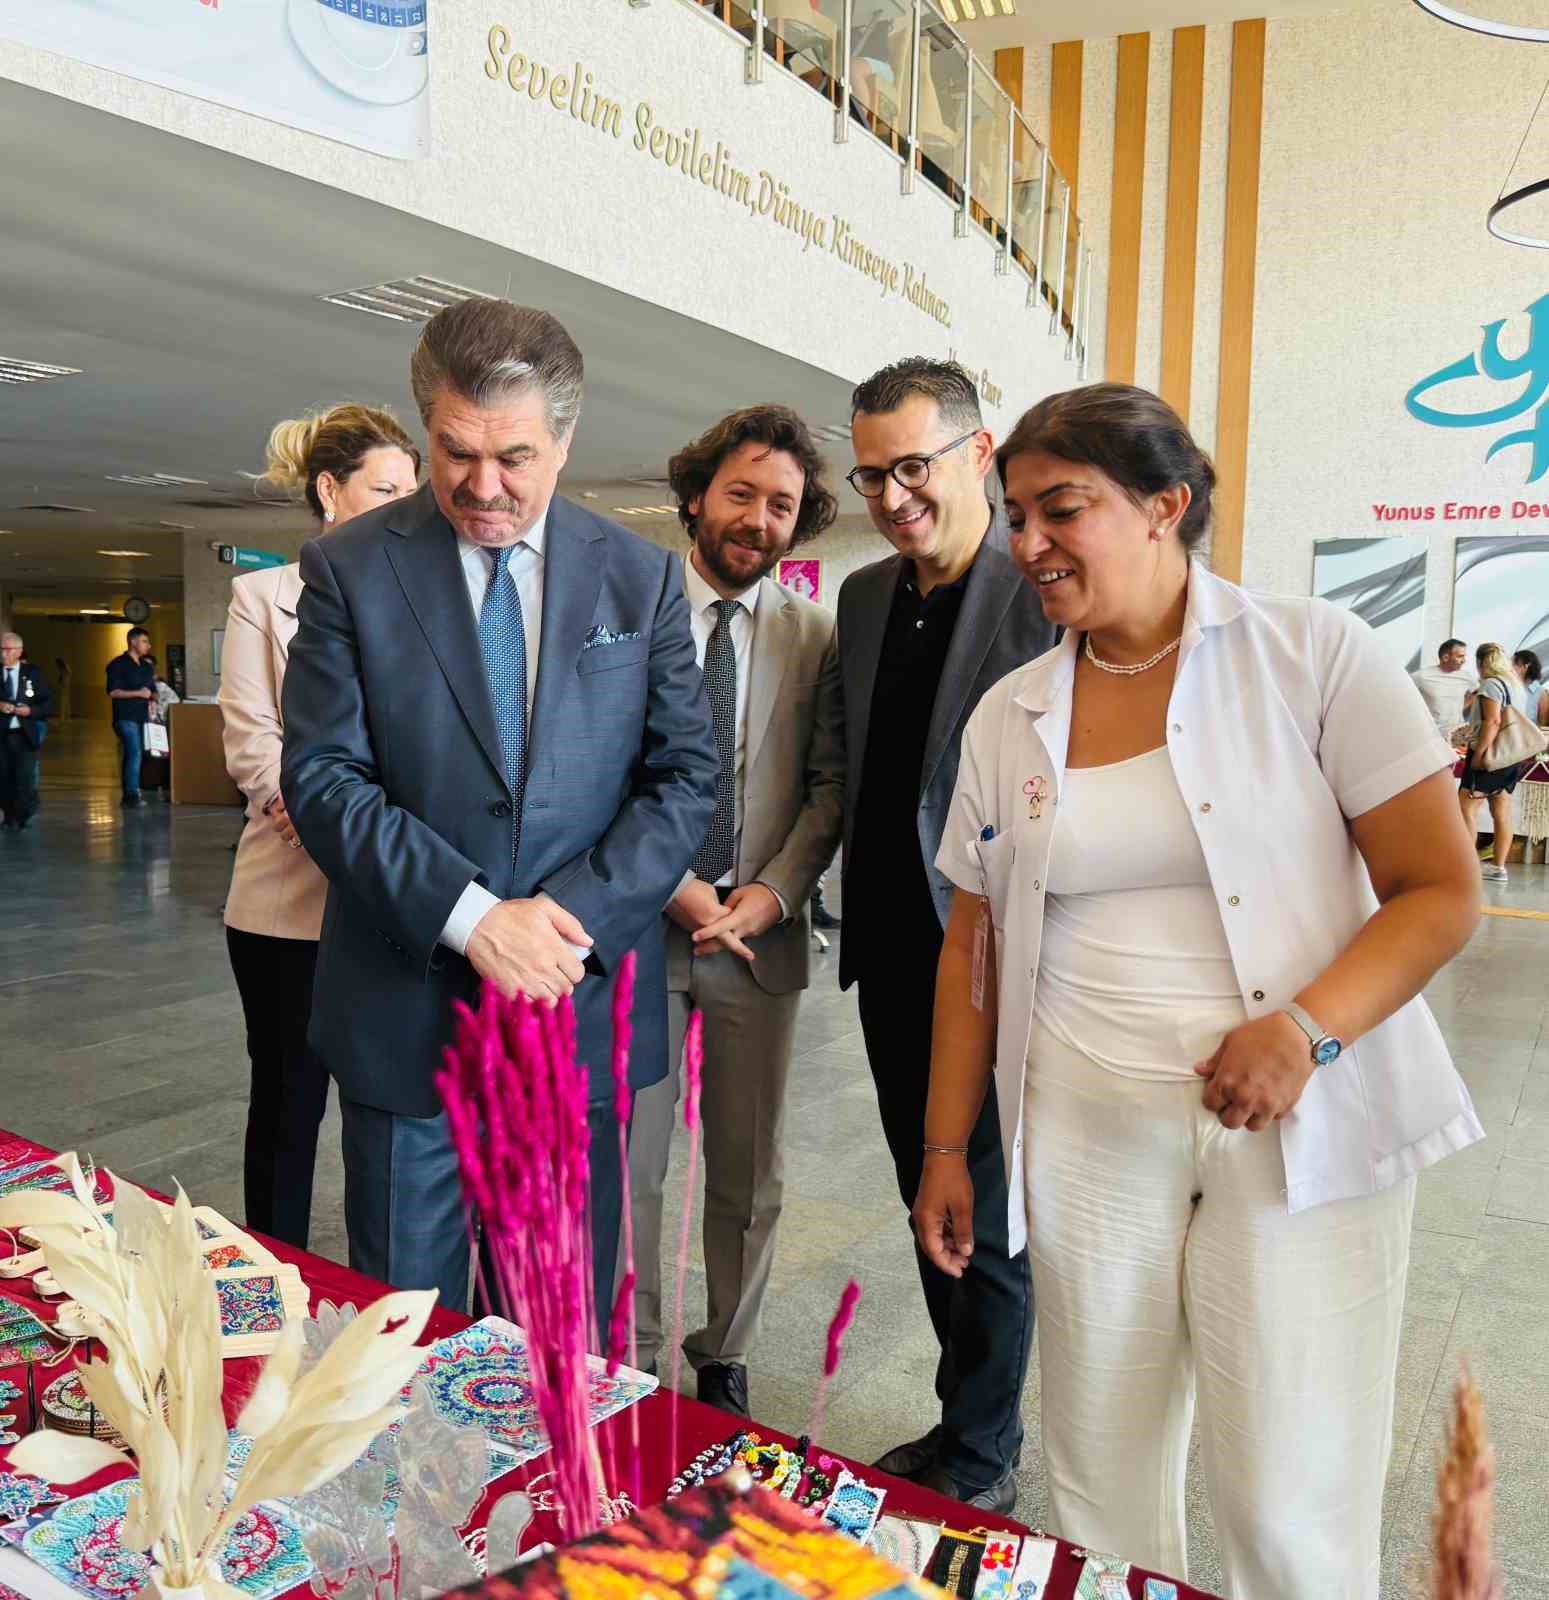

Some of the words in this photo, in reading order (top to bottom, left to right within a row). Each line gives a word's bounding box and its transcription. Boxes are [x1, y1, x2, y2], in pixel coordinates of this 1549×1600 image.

[484, 23, 622, 138] Sevelim
[830, 214, 898, 298] Kimseye
[1372, 503, 1436, 521] Yunus
[1443, 502, 1502, 520] Emre
